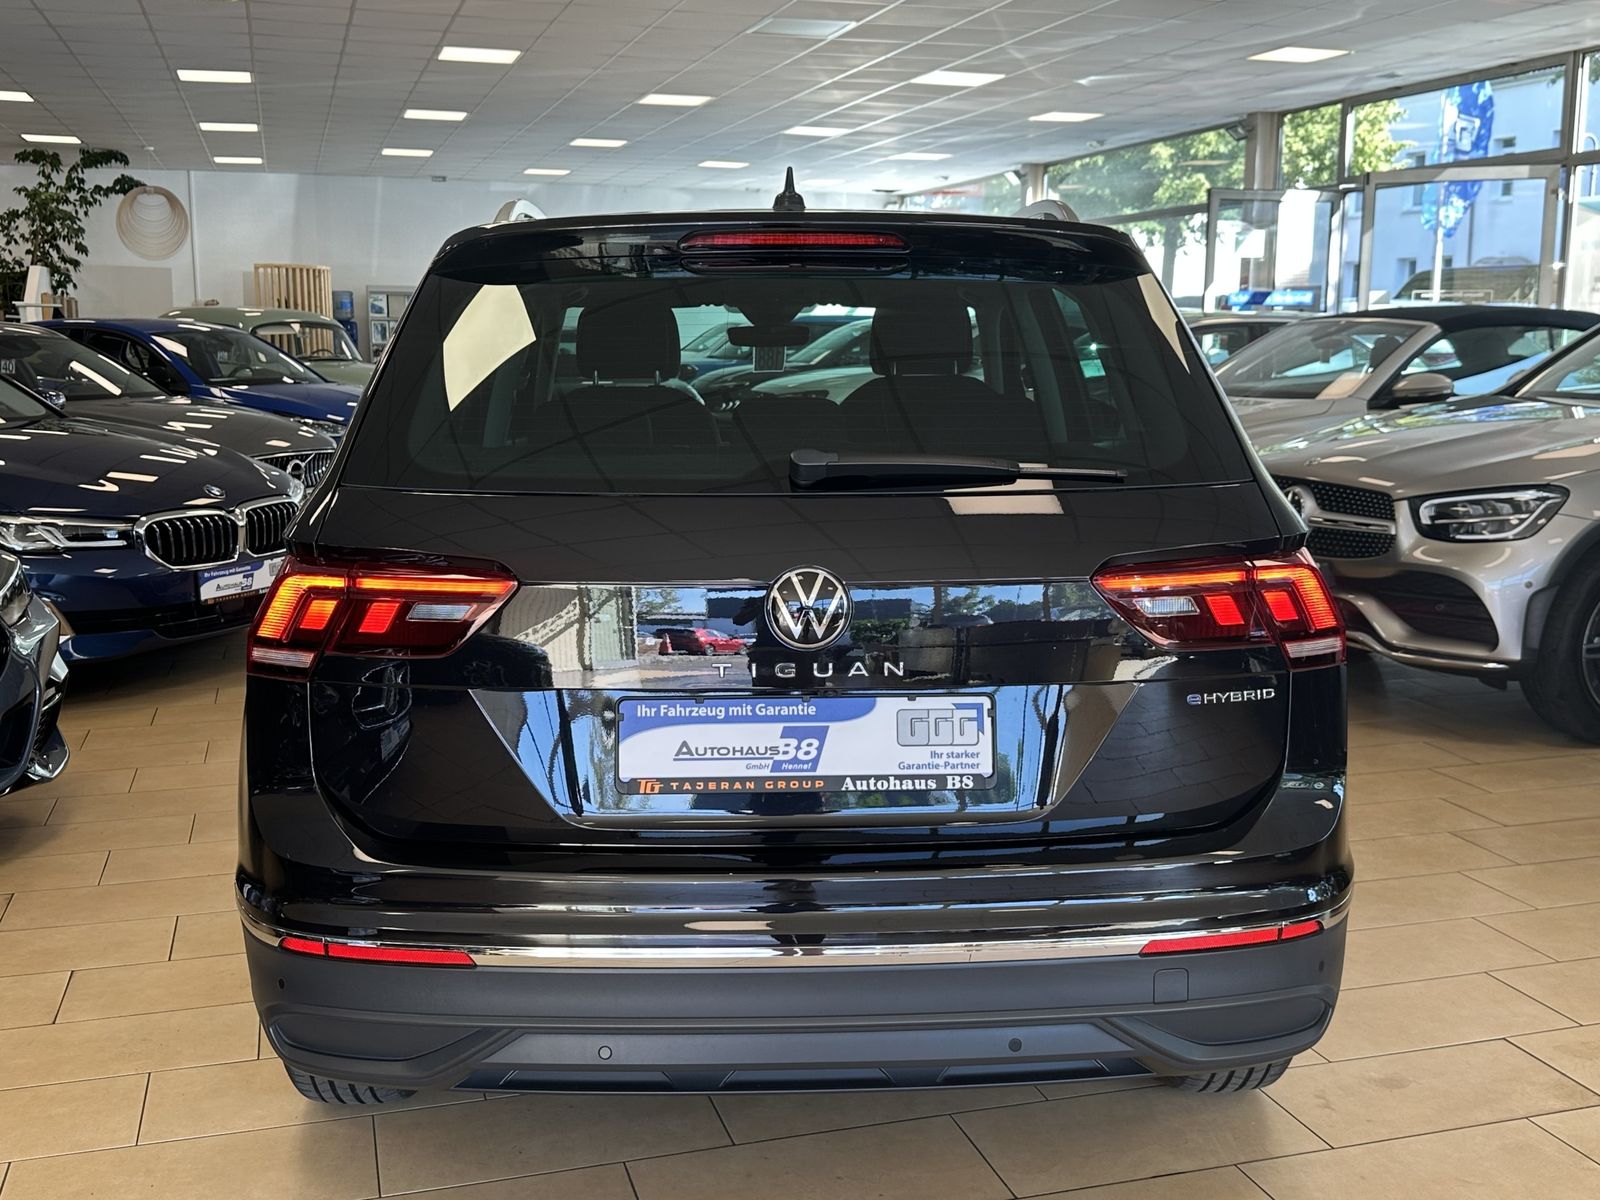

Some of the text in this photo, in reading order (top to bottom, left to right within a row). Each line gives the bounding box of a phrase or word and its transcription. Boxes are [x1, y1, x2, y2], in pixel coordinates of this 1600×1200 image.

[711, 661, 905, 678] TIGUAN
[637, 702, 817, 719] Ihr Fahrzeug mit Garantie
[930, 750, 980, 759] Ihr starker
[745, 762, 812, 770] GmbH Hennef
[898, 761, 981, 770] Garantie-Partner
[670, 781, 755, 791] TAJERAN
[765, 780, 825, 789] GROUP
[841, 777, 937, 791] Autohaus
[946, 775, 974, 789] B8
